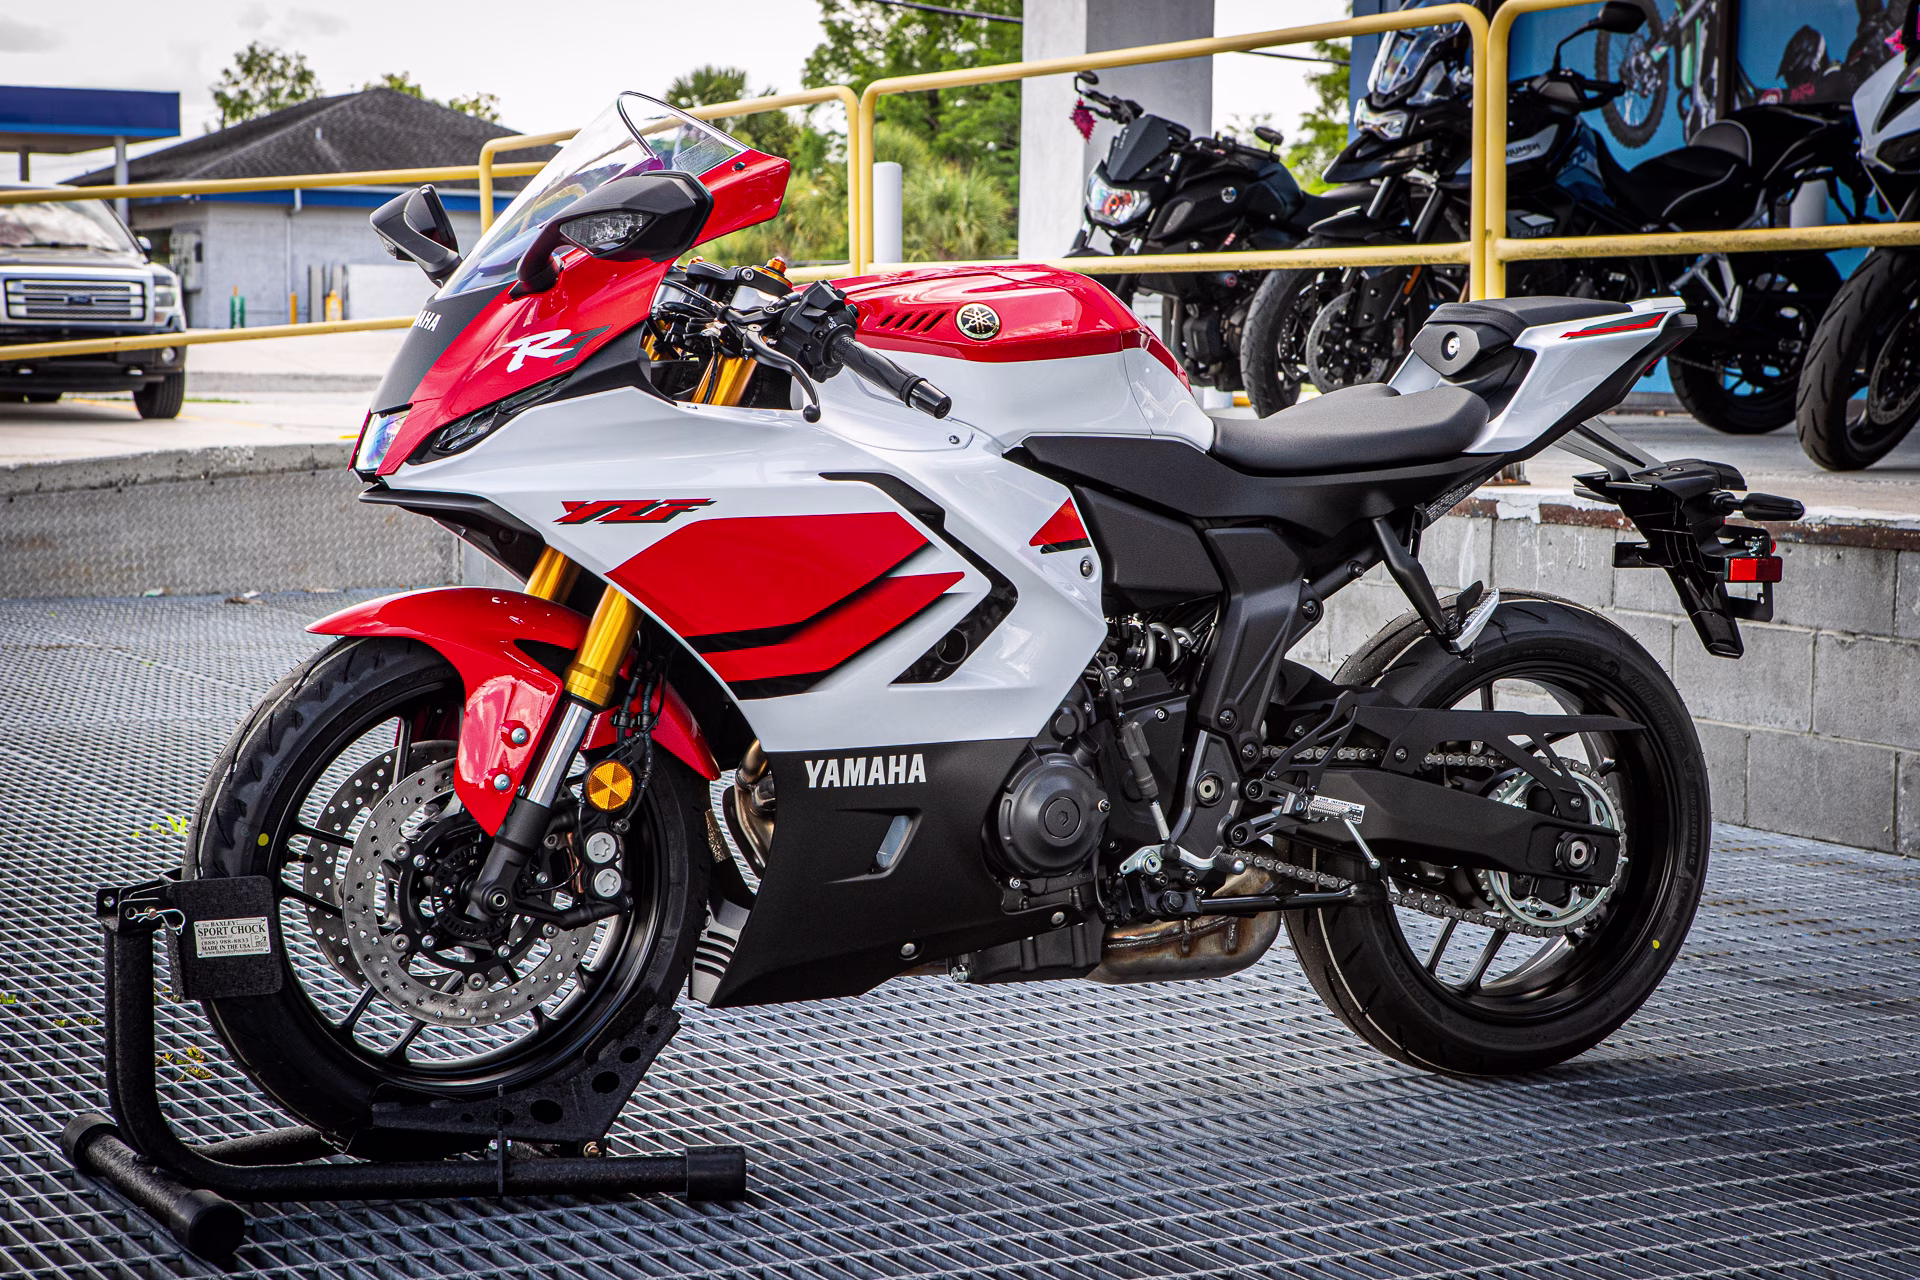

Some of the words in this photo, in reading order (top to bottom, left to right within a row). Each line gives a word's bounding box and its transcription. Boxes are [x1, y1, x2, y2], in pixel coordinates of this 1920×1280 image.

[502, 324, 613, 373] R7
[552, 498, 717, 525] YZF
[804, 753, 926, 788] YAMAHA
[198, 927, 228, 936] SPORT
[230, 924, 266, 934] CHOCK
